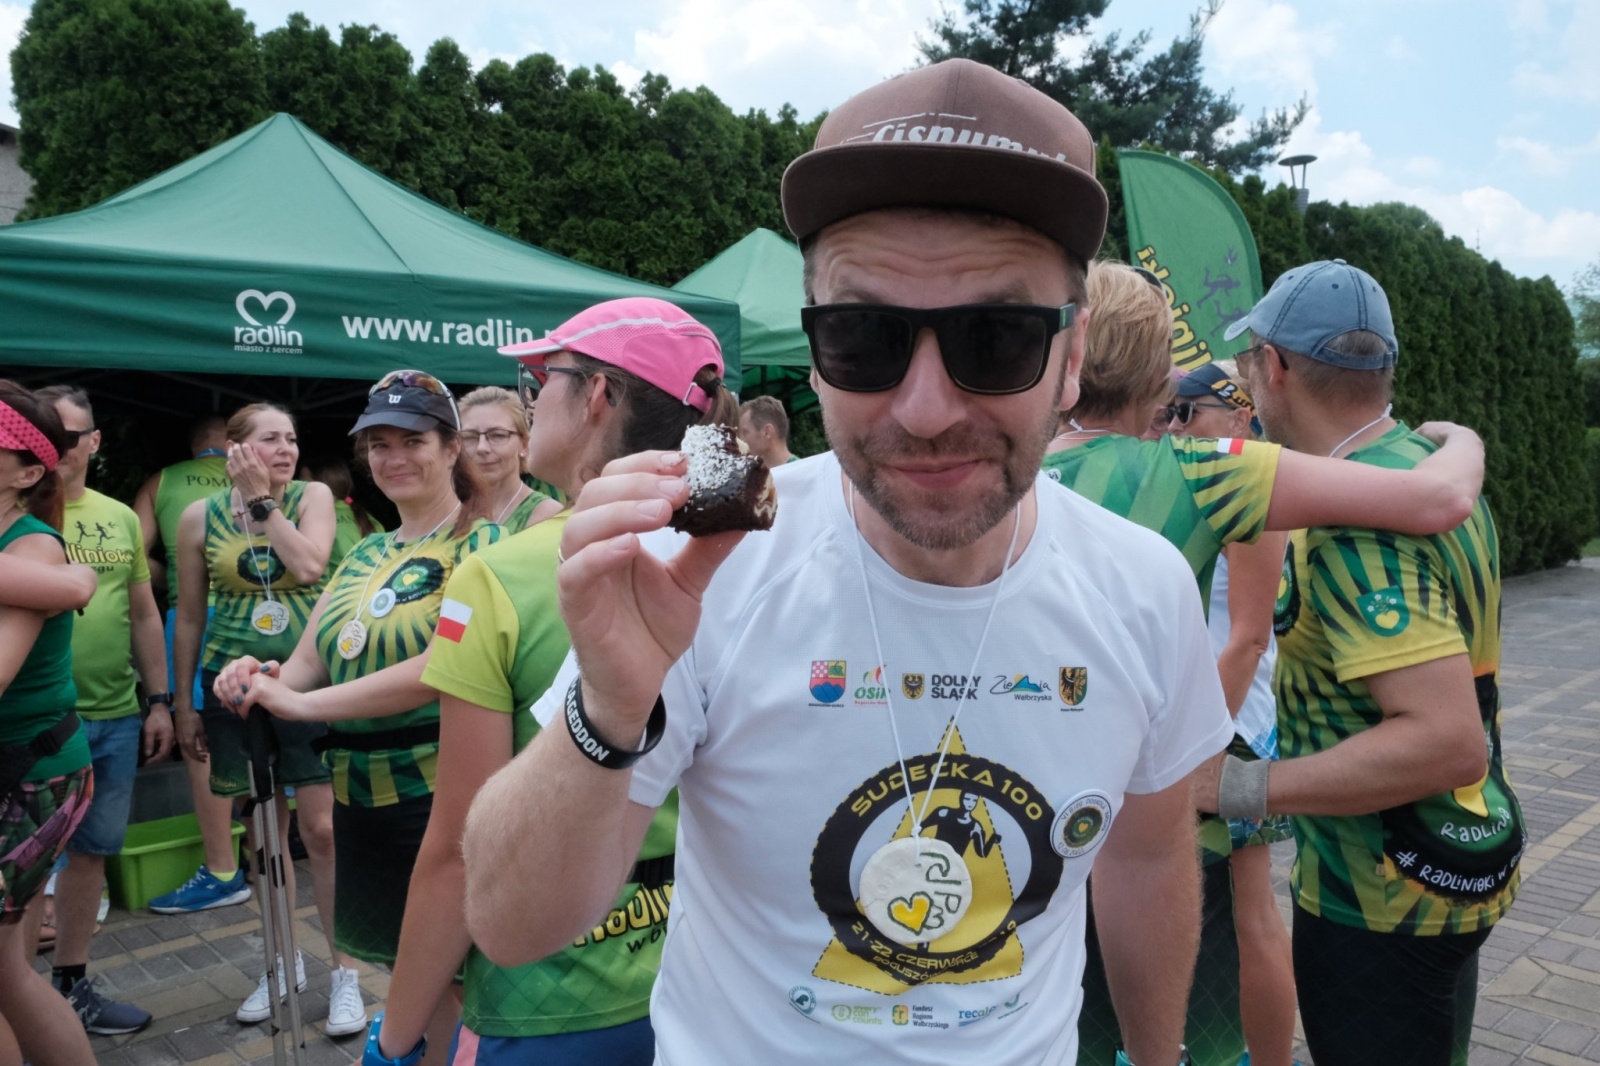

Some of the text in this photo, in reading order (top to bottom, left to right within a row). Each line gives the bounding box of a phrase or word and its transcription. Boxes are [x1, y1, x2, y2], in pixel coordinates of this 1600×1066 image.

[234, 325, 303, 347] radlin
[342, 315, 552, 348] www.radlin
[234, 344, 264, 353] miasto
[272, 347, 303, 355] sercem
[186, 475, 232, 488] POM
[931, 674, 981, 687] DOLNY
[931, 684, 978, 701] ŚLĄSK
[1014, 693, 1052, 702] Wałbrzyska
[851, 761, 1043, 821] SUDECKA 100
[912, 1004, 933, 1012] Fundusz
